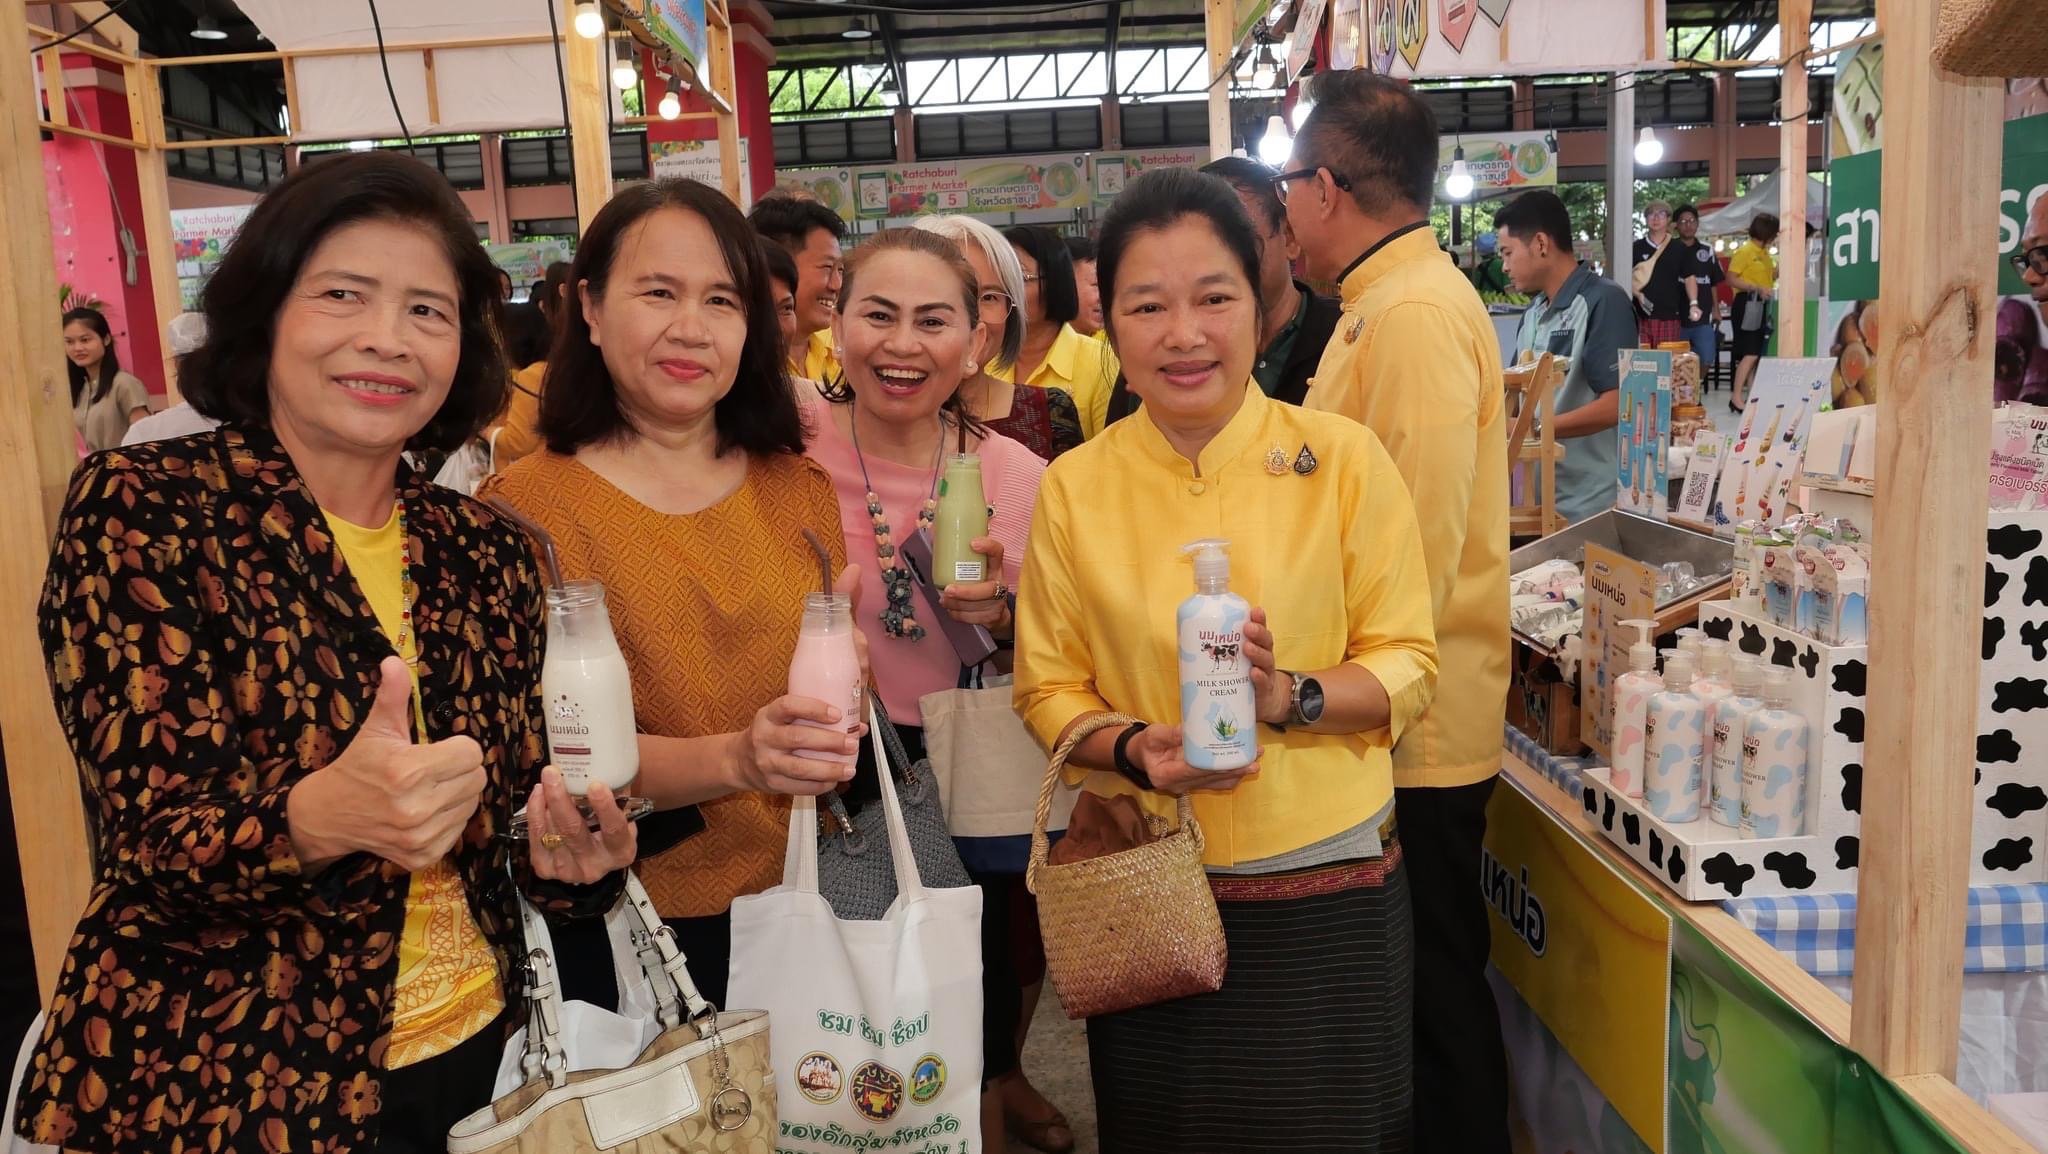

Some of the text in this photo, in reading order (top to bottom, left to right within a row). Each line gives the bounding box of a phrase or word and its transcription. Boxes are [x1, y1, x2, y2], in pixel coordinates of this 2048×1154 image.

[1141, 152, 1195, 165] Ratchaburi
[902, 167, 957, 180] Ratchaburi
[893, 179, 968, 193] Farmer Market
[970, 184, 1040, 195] ตลาดเกษตรกร
[947, 194, 957, 207] 5
[183, 214, 236, 225] Ratchaburi
[1199, 630, 1241, 644] นมเหน่อ
[1196, 675, 1250, 688] MILK SHOWER
[1209, 688, 1238, 697] CREAM
[550, 722, 589, 735] นมเหน่อ
[818, 1011, 853, 1034] ชม
[860, 1016, 883, 1047] ชิม
[779, 1115, 960, 1154] ของดีกลุ่มจังหวัด
